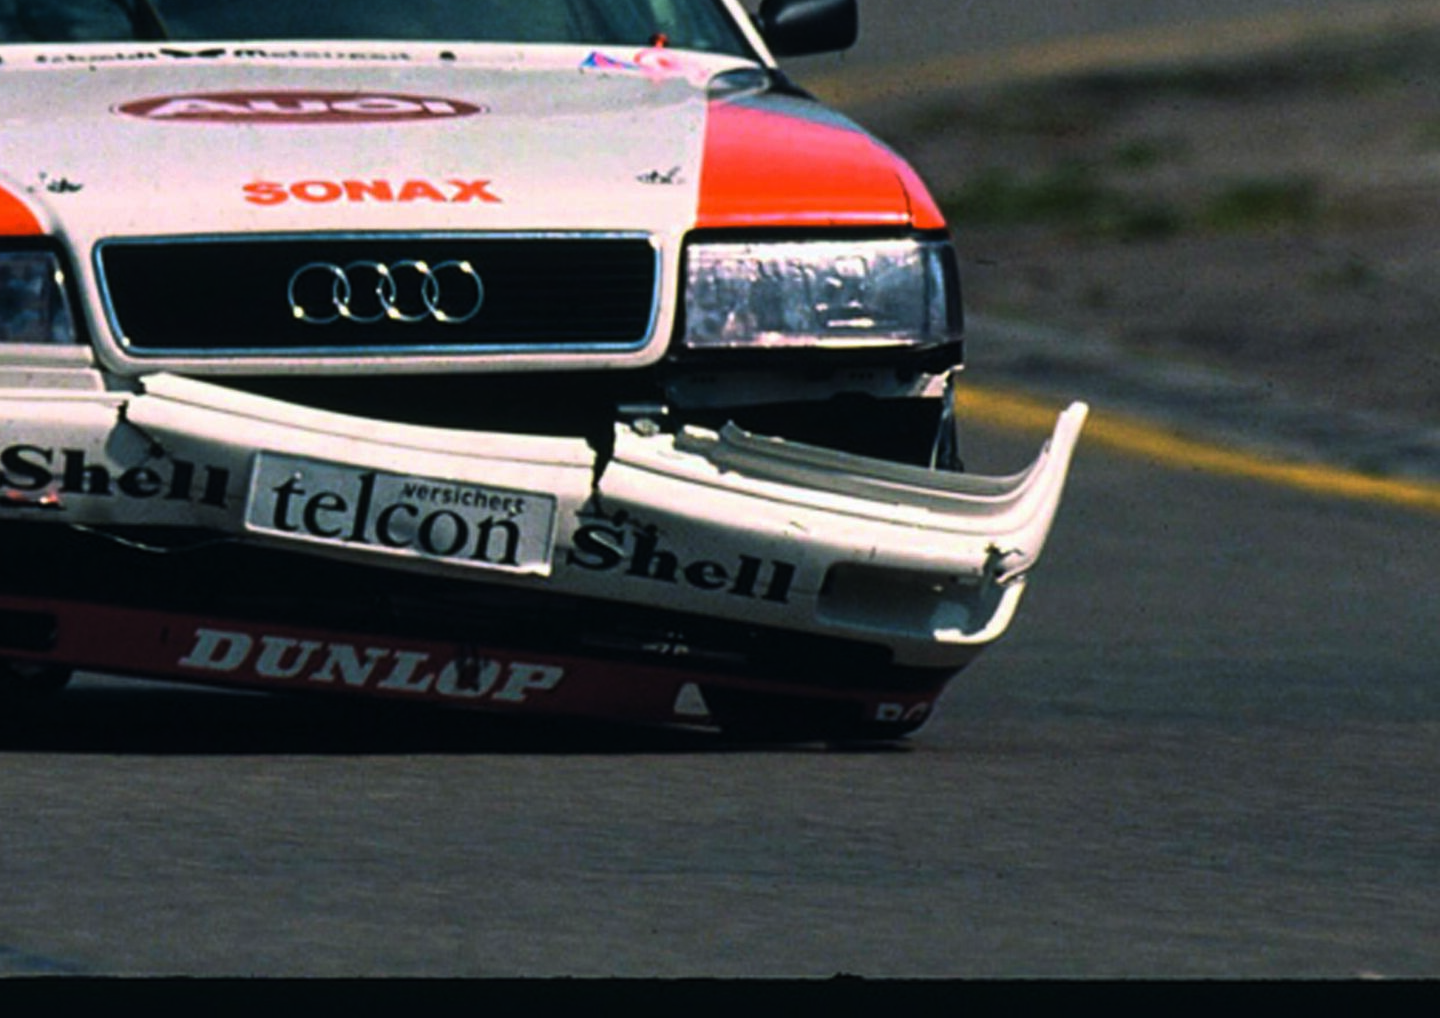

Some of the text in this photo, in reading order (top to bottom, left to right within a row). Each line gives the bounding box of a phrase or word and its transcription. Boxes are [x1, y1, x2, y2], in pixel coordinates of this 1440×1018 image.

[242, 180, 503, 206] SONAX
[272, 472, 521, 566] telcon
[401, 481, 527, 514] versichert
[565, 522, 796, 604] Shell
[178, 627, 564, 702] DUNLOP
